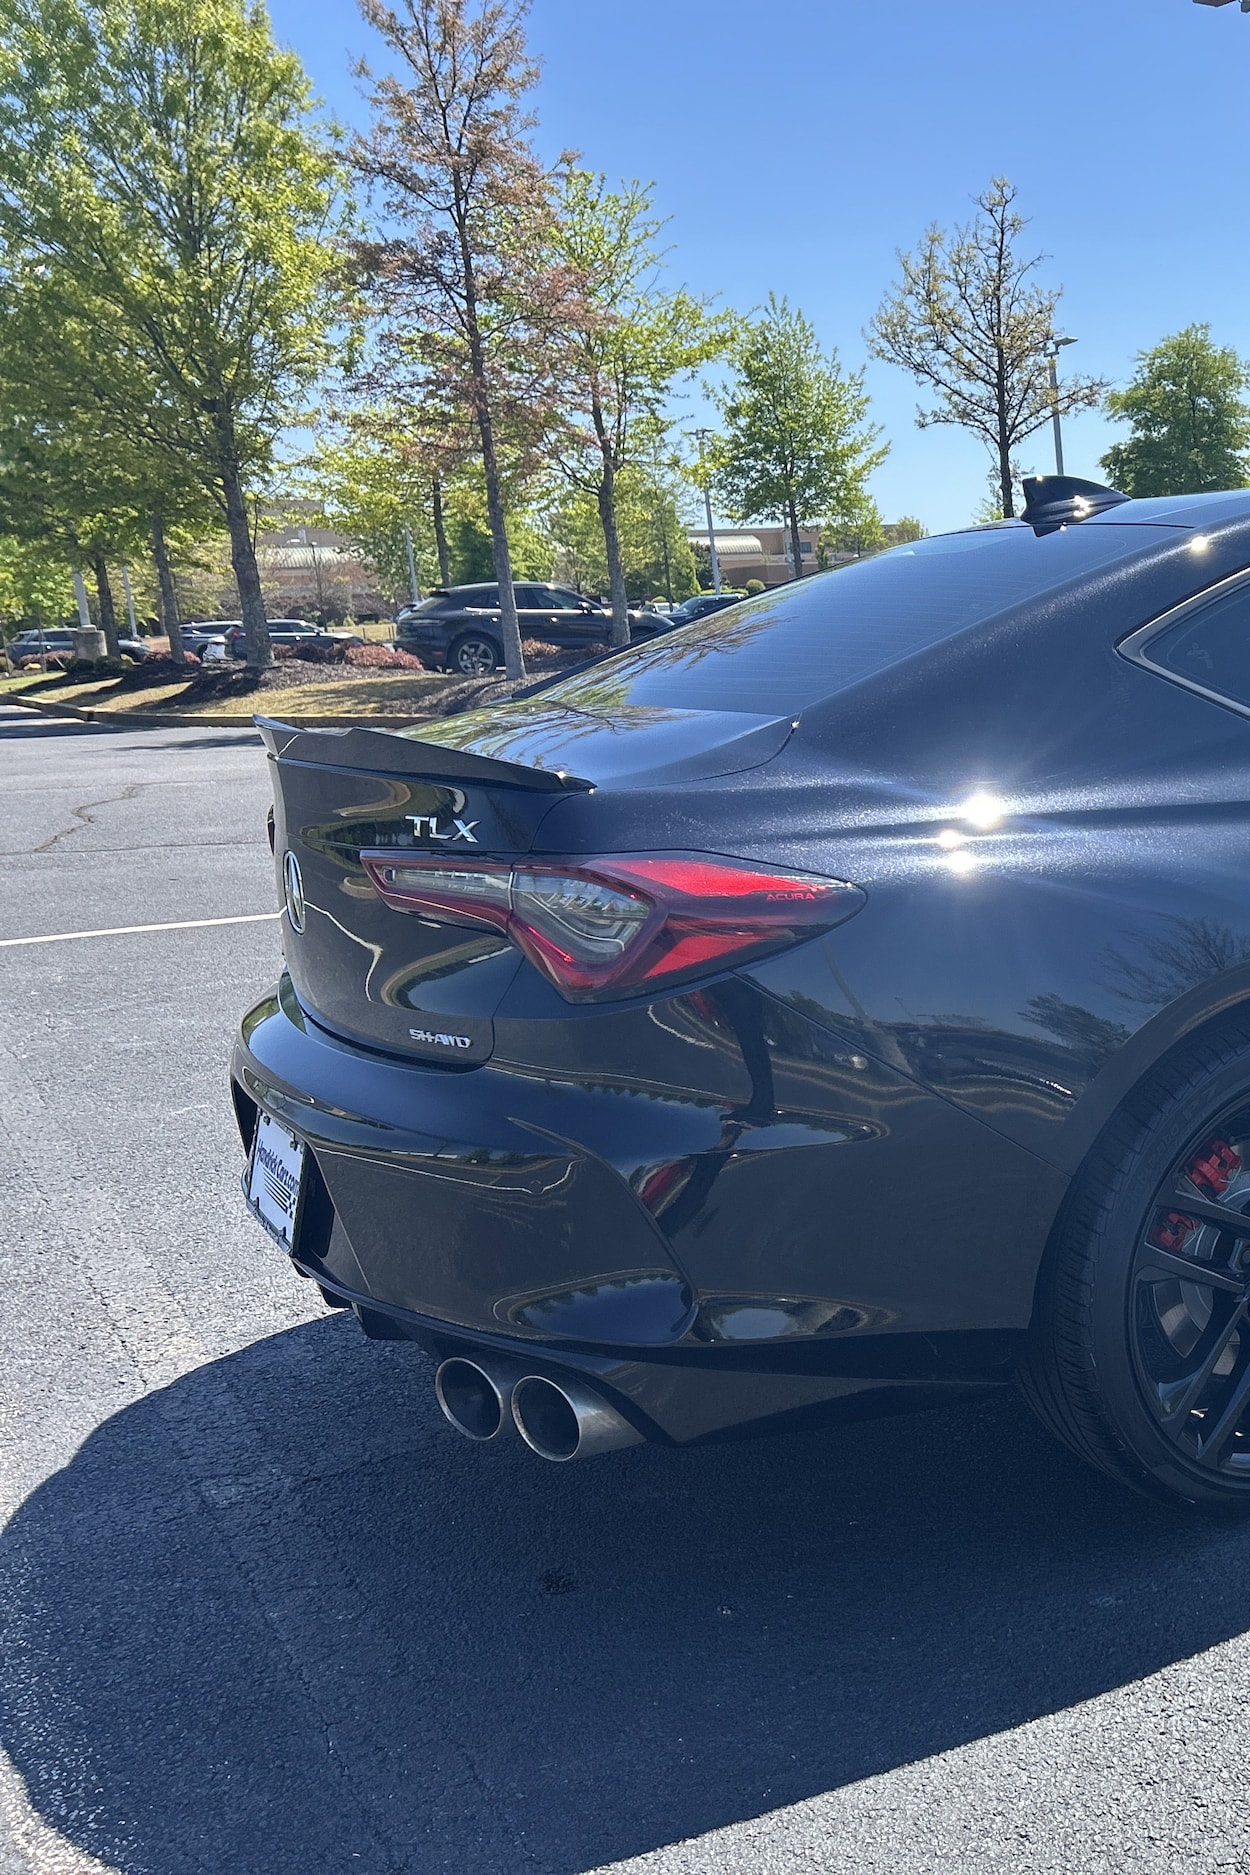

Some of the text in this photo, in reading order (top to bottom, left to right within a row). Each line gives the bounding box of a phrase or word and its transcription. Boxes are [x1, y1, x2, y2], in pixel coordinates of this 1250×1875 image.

[405, 815, 480, 843] TLX
[766, 892, 815, 901] ACURA
[409, 1028, 471, 1048] SH-AWD
